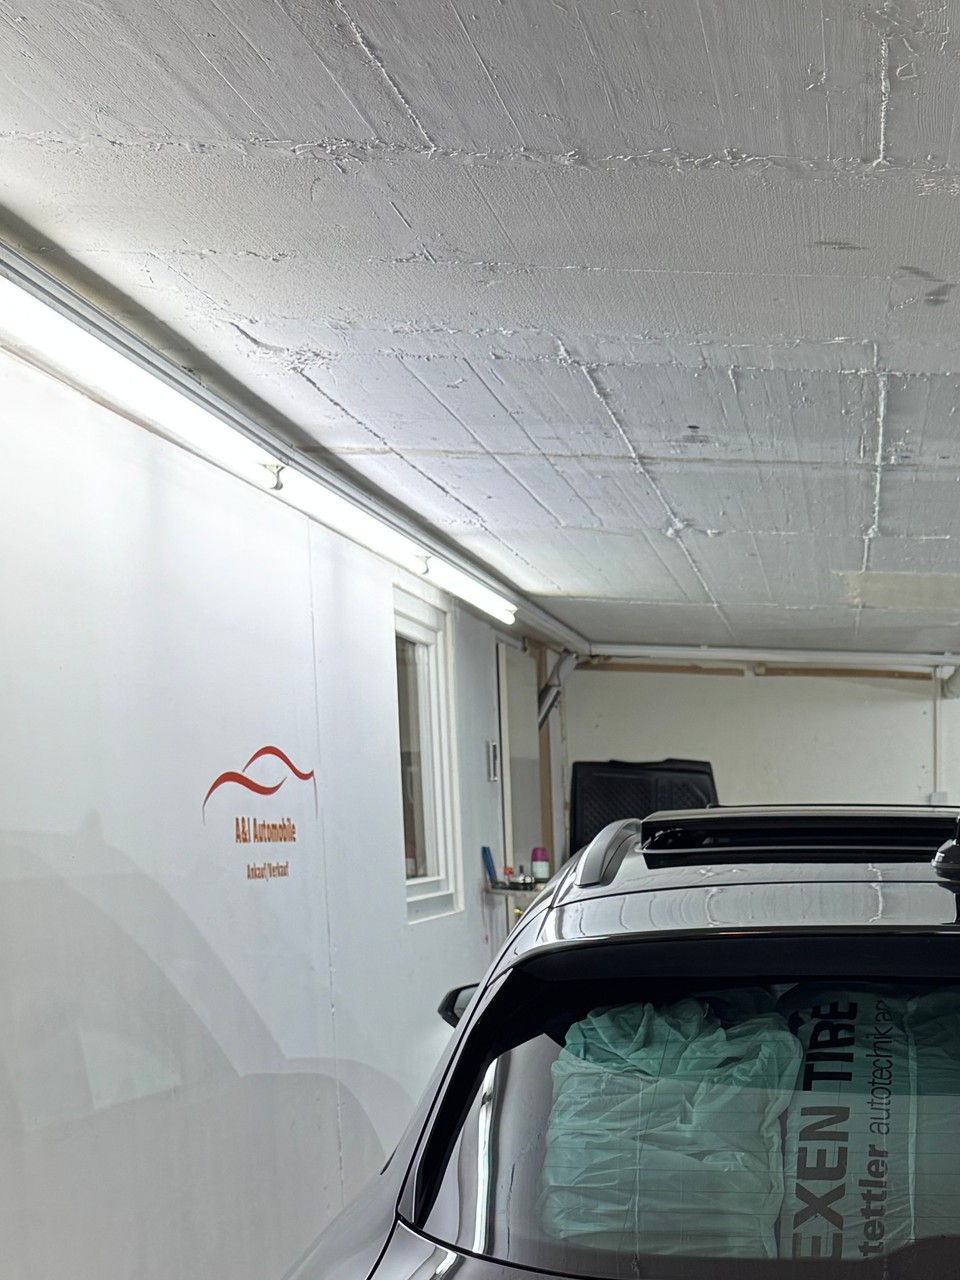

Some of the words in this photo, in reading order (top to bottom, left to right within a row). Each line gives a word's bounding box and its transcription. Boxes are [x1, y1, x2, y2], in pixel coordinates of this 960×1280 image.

[235, 816, 251, 843] A&I
[253, 817, 297, 842] Automobile
[866, 1026, 894, 1136] autotechnik
[858, 1144, 889, 1257] tettler
